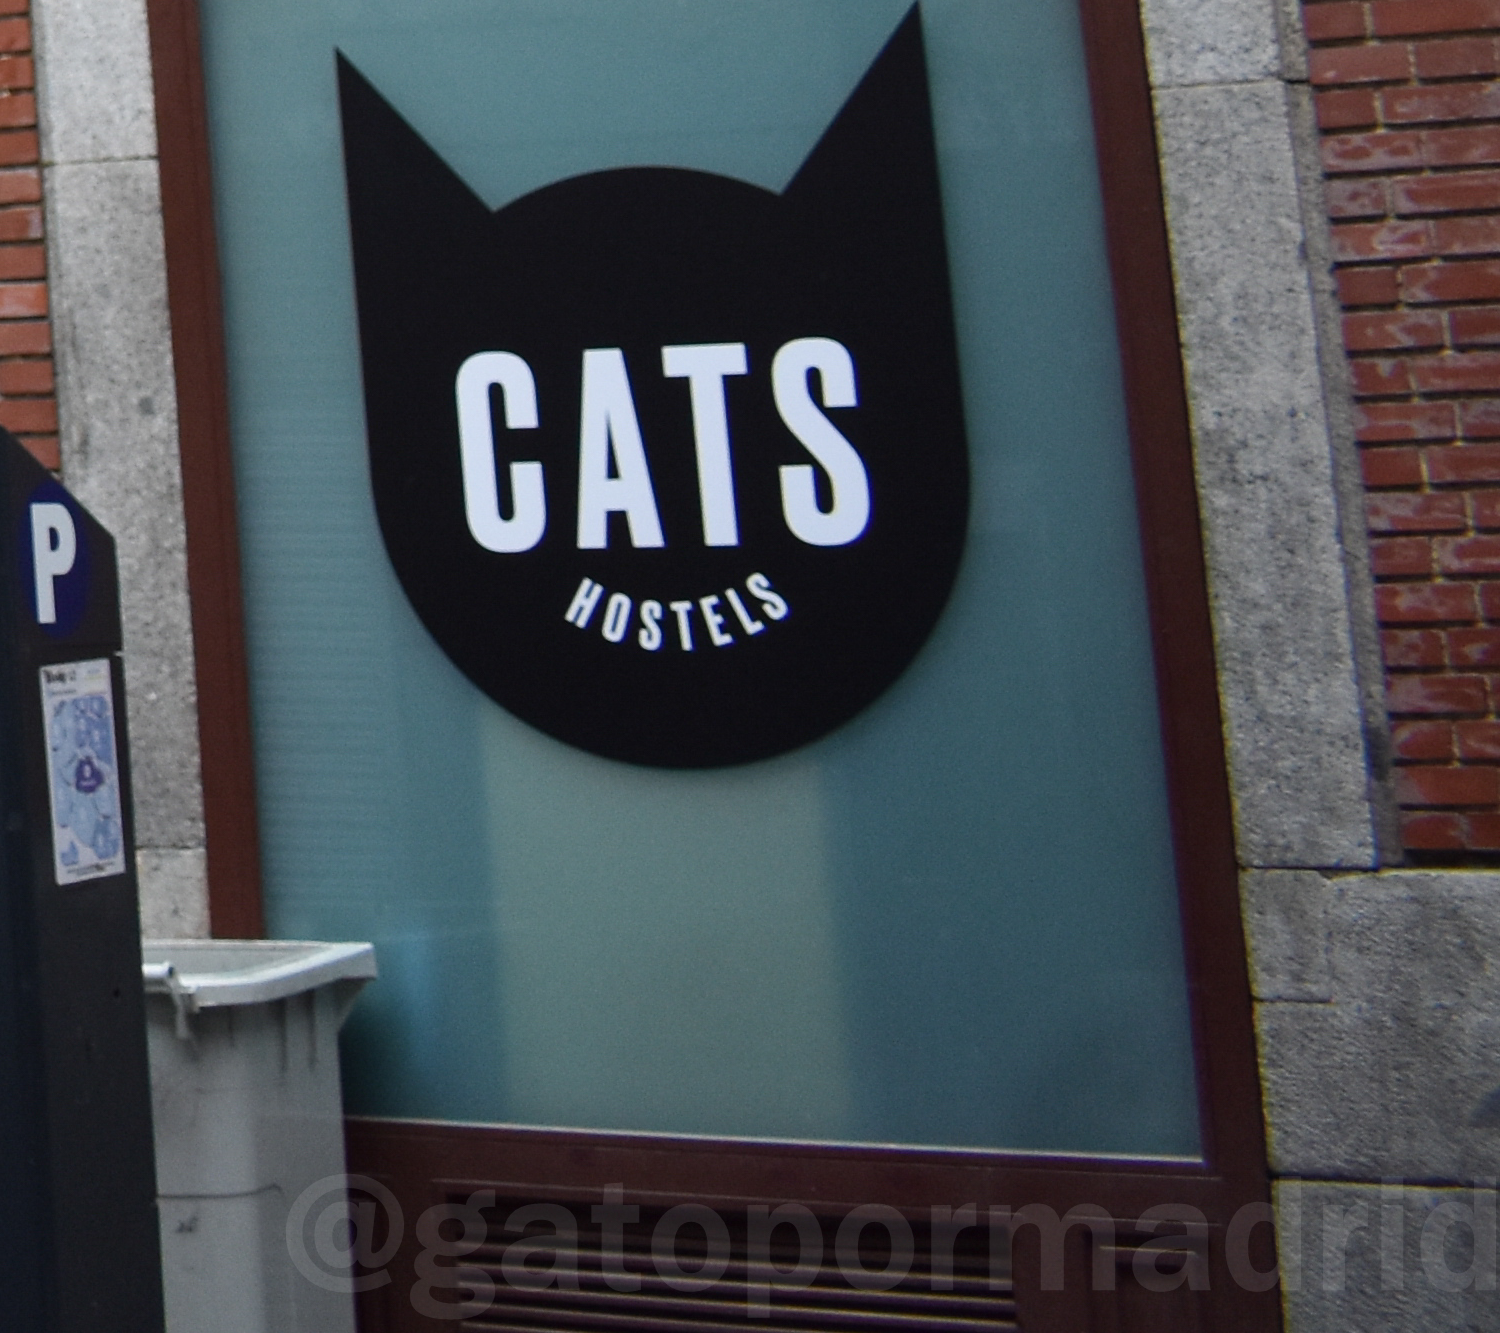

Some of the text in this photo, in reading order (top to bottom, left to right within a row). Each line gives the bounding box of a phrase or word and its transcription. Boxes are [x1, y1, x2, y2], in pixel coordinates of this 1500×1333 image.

[454, 336, 872, 554] CATS
[30, 501, 77, 624] P
[563, 571, 790, 652] HOSTELS
